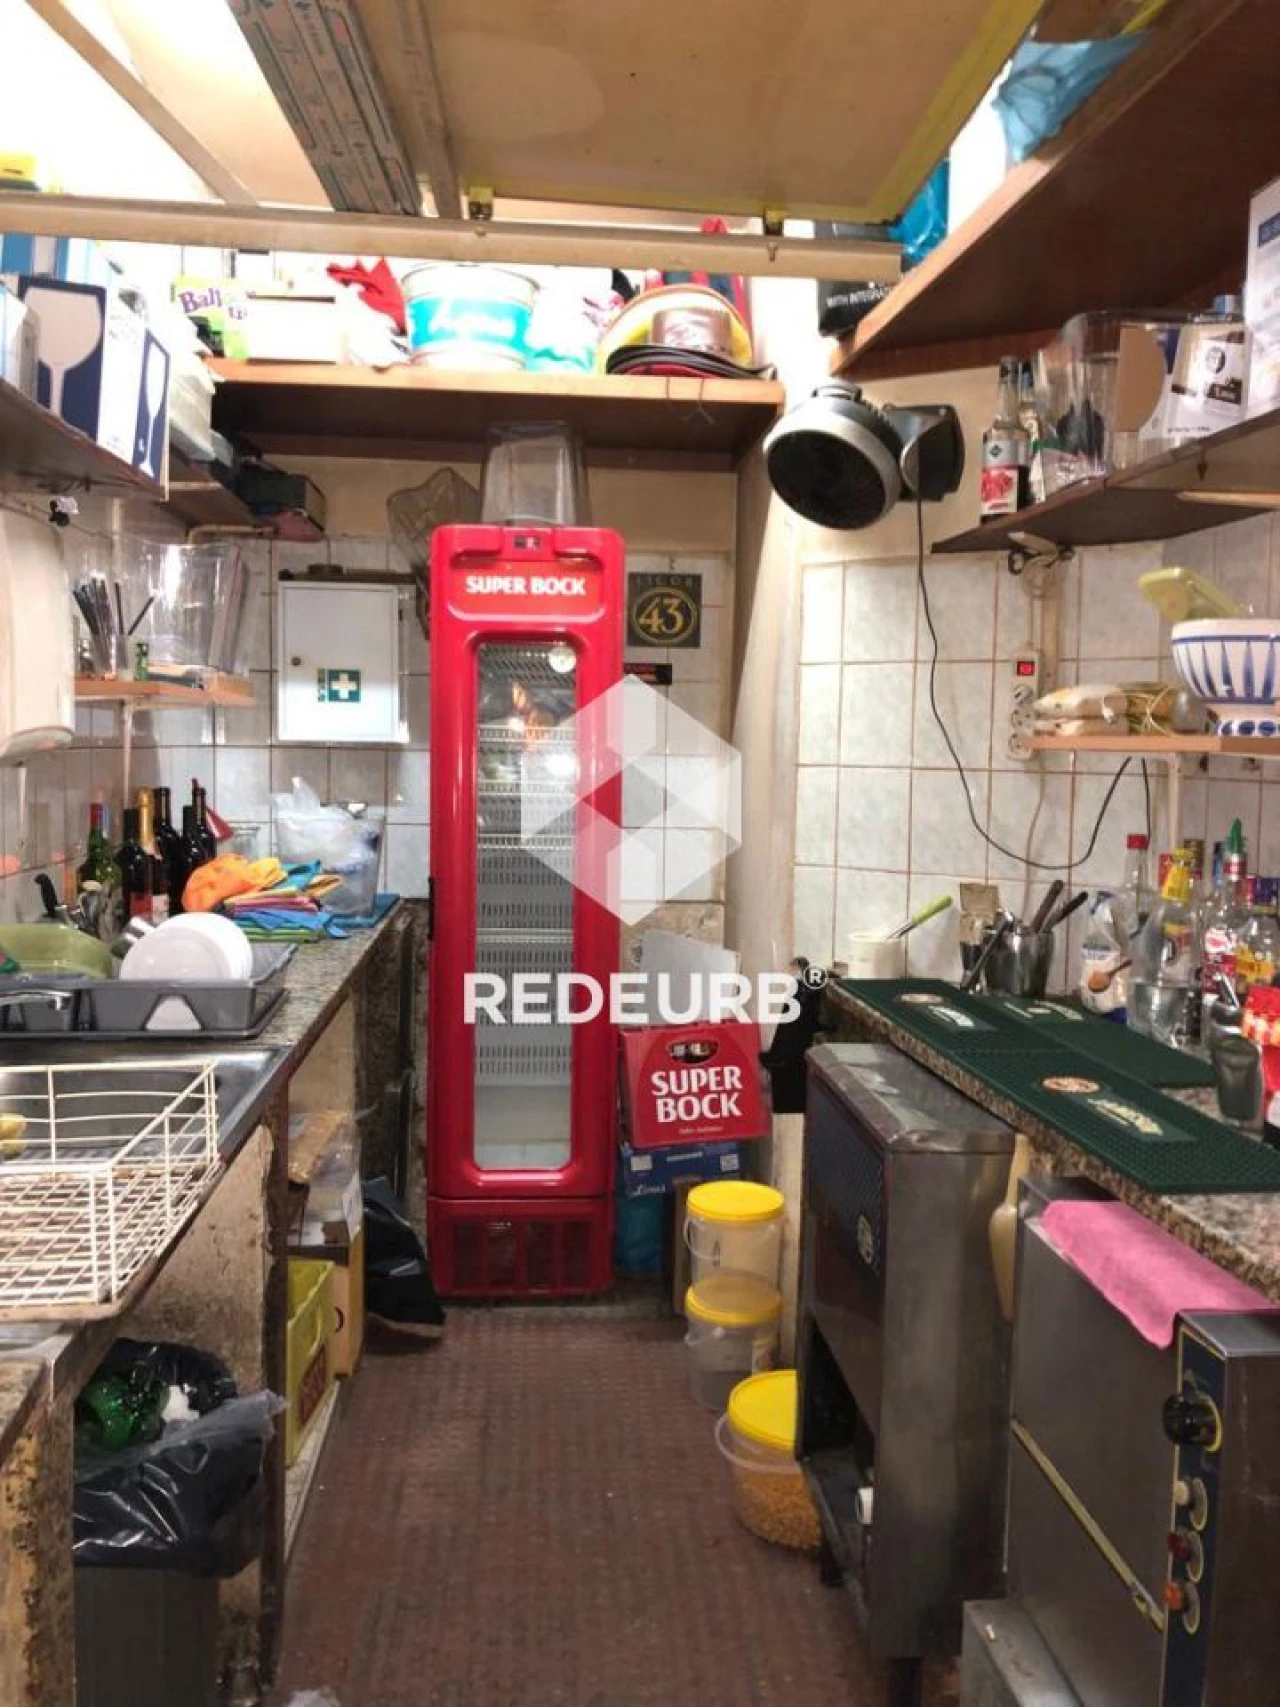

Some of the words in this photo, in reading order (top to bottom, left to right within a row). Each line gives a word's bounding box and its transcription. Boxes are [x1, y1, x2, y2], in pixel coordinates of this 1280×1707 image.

[466, 575, 526, 595] SUPER
[530, 576, 586, 596] BOCK
[637, 597, 684, 635] 43
[651, 1064, 743, 1096] SUPER
[656, 1092, 743, 1123] BOCK
